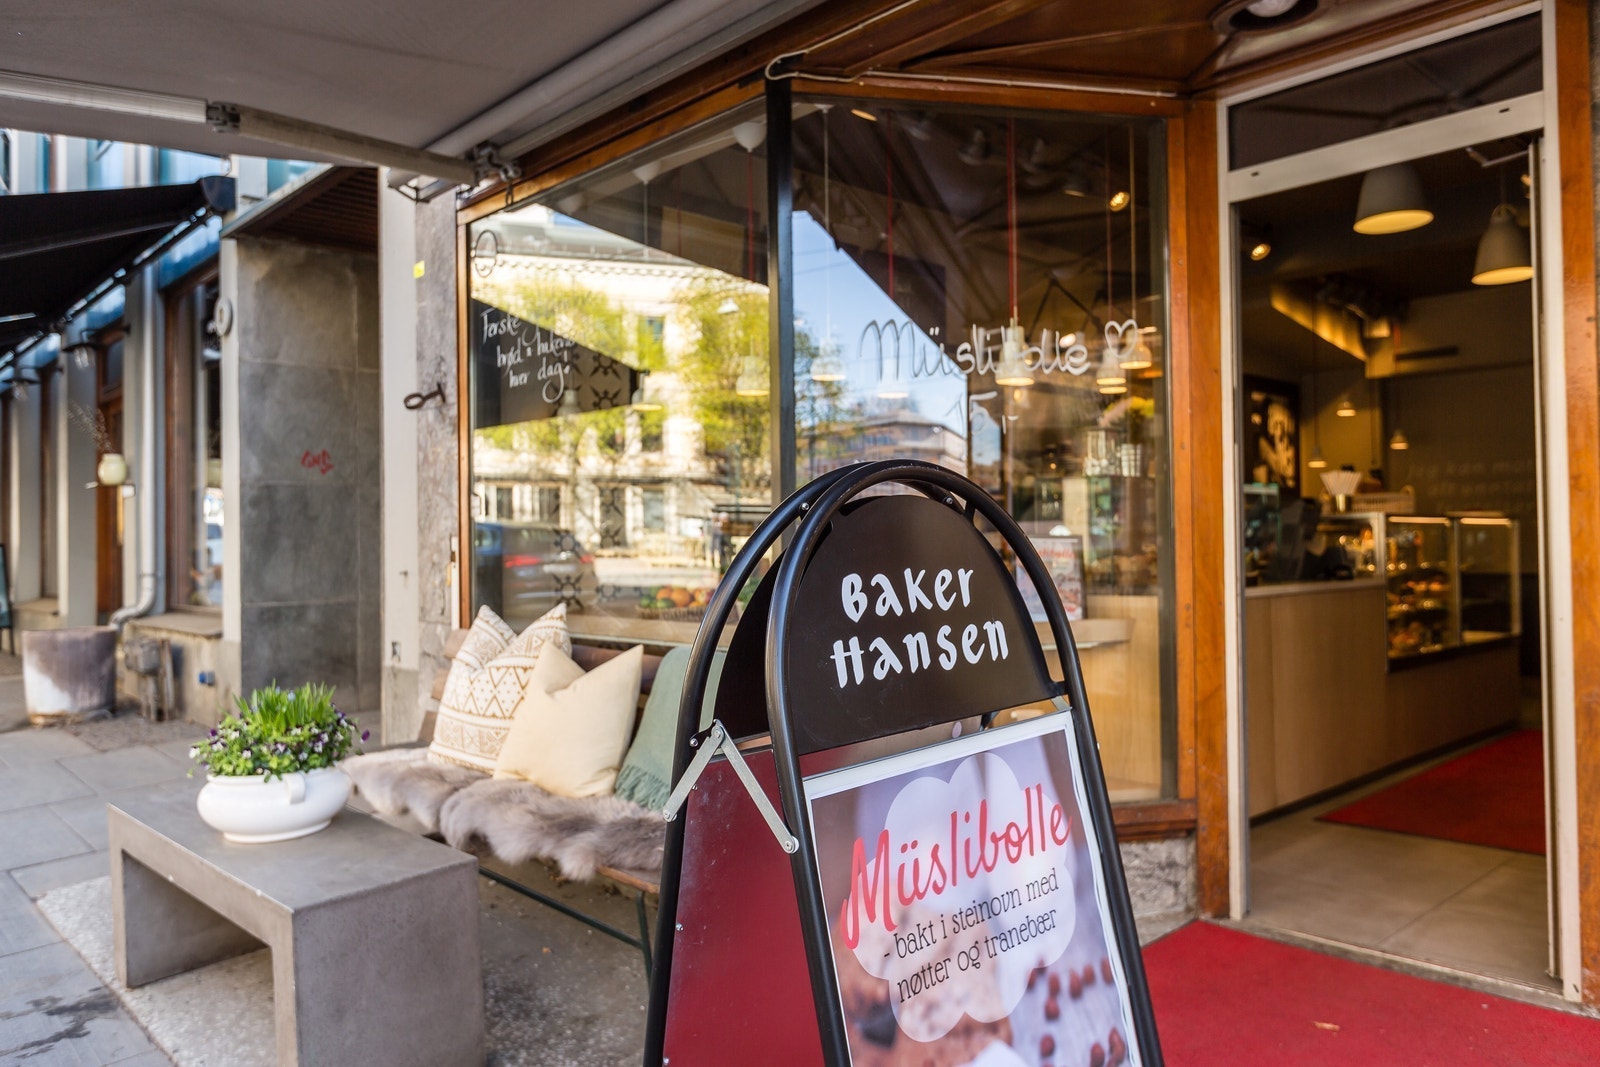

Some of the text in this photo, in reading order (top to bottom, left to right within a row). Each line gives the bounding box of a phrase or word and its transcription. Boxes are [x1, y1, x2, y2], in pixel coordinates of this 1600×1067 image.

[830, 620, 1009, 689] Hansen
[841, 784, 1073, 950] Müslibolle
[893, 919, 938, 959] bakt
[940, 914, 948, 940] i
[952, 888, 1023, 935] steinovn
[1026, 868, 1060, 903] med
[897, 909, 1058, 1004] nøtter og tranebær
